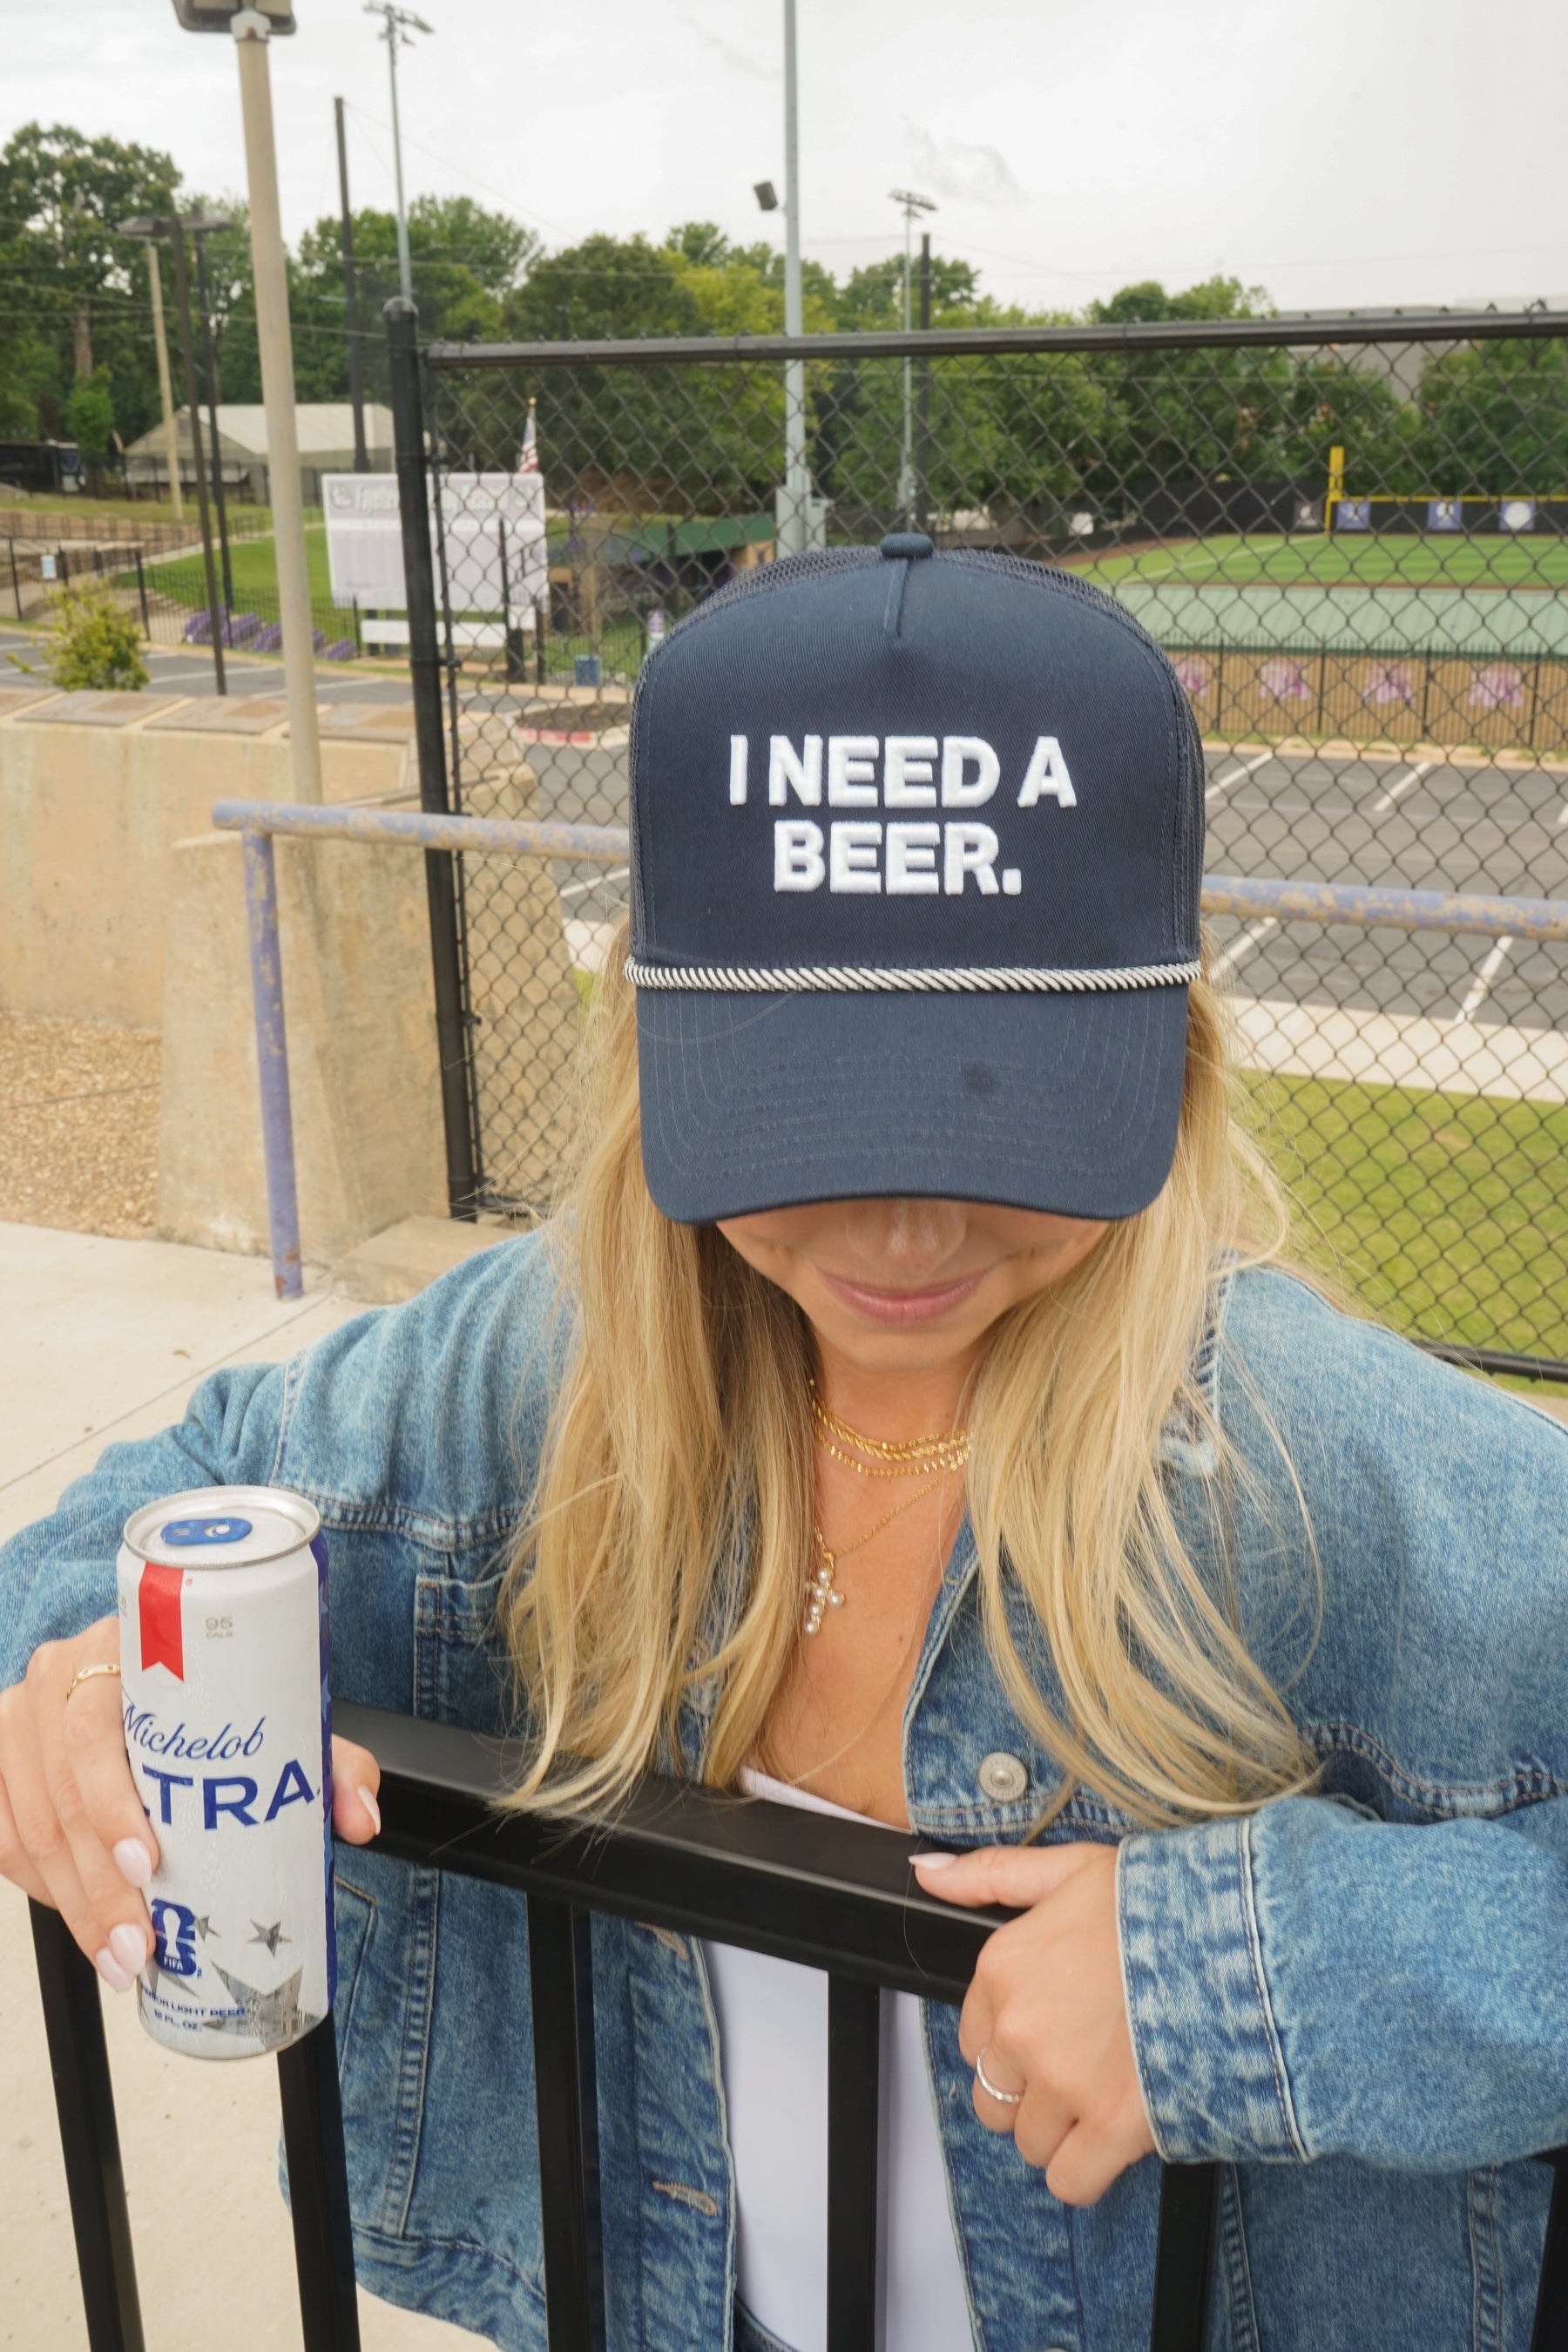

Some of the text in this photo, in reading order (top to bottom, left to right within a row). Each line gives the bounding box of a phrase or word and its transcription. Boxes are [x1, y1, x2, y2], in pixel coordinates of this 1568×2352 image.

[730, 733, 1078, 808] I NEED A
[774, 819, 1023, 896] BEER.
[205, 1616, 233, 1630] 95
[124, 1703, 266, 1761] Michelob
[142, 1759, 314, 1830] TRA
[164, 1955, 183, 1971] FIFA
[171, 2002, 206, 2016] LIGHT
[209, 2006, 246, 2017] BEER
